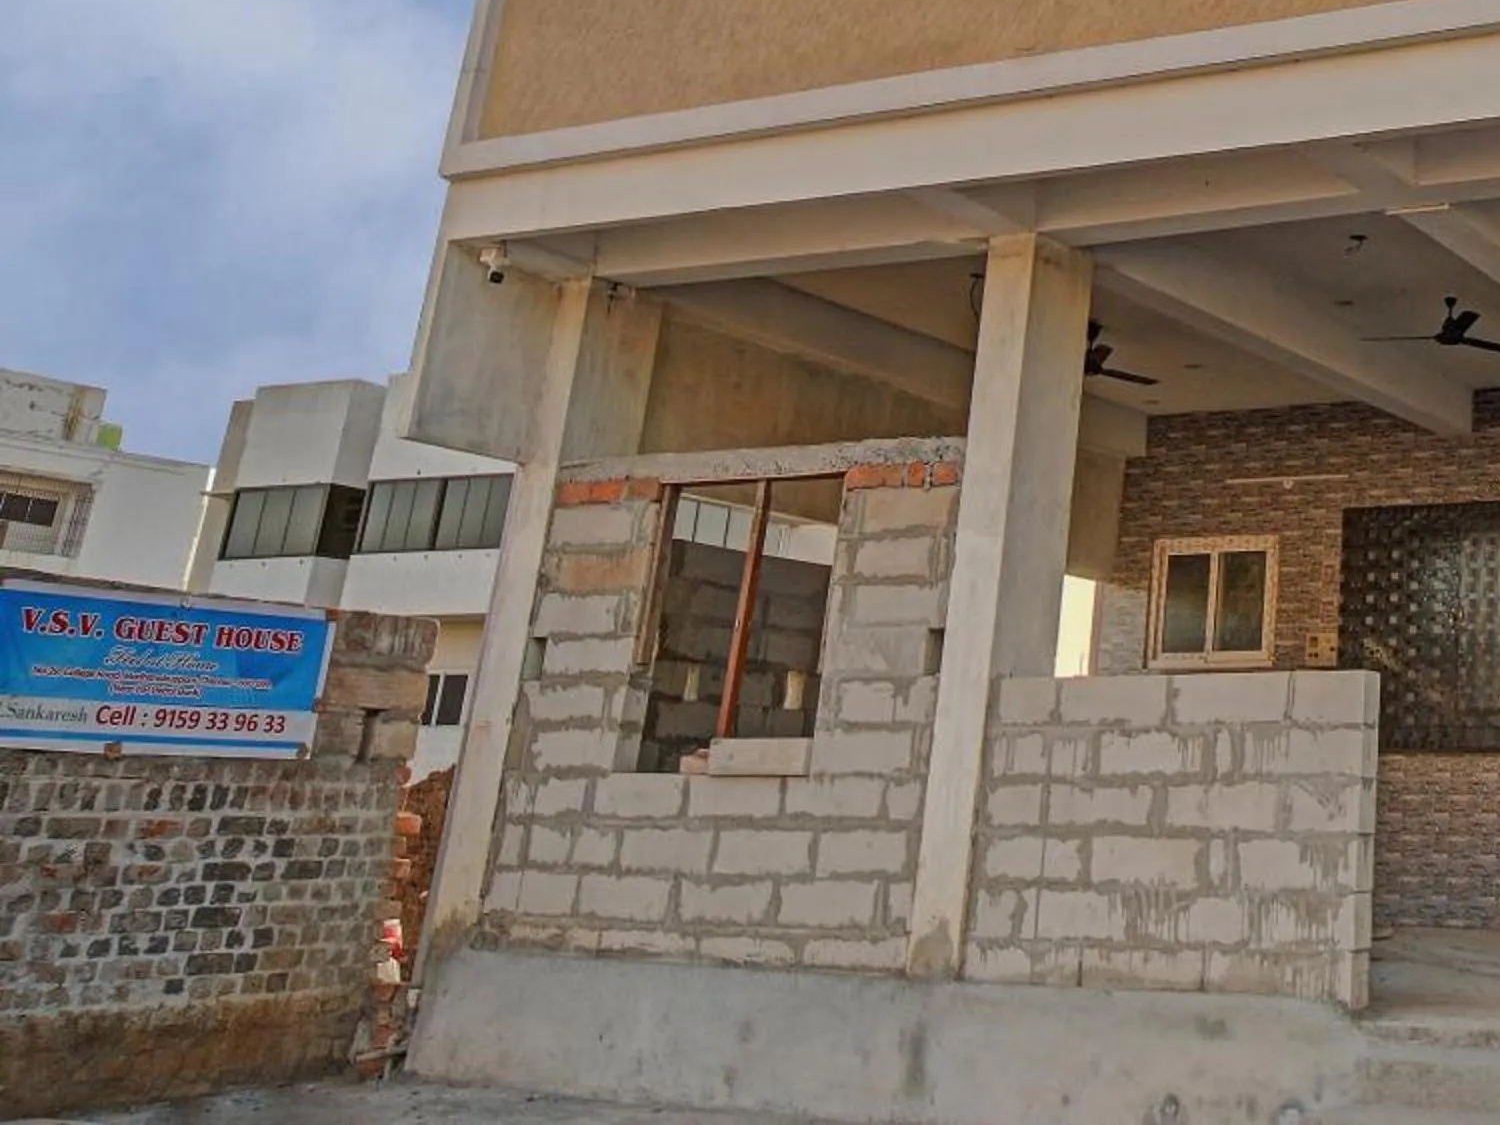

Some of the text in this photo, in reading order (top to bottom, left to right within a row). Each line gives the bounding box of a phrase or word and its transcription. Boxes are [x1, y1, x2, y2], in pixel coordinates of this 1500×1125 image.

[21, 606, 304, 654] V.S.V. GUEST HOUSE
[95, 704, 137, 727] Cell
[153, 708, 201, 730] 9159
[205, 711, 230, 732] 33
[233, 713, 259, 733] 96
[263, 714, 287, 734] 33
